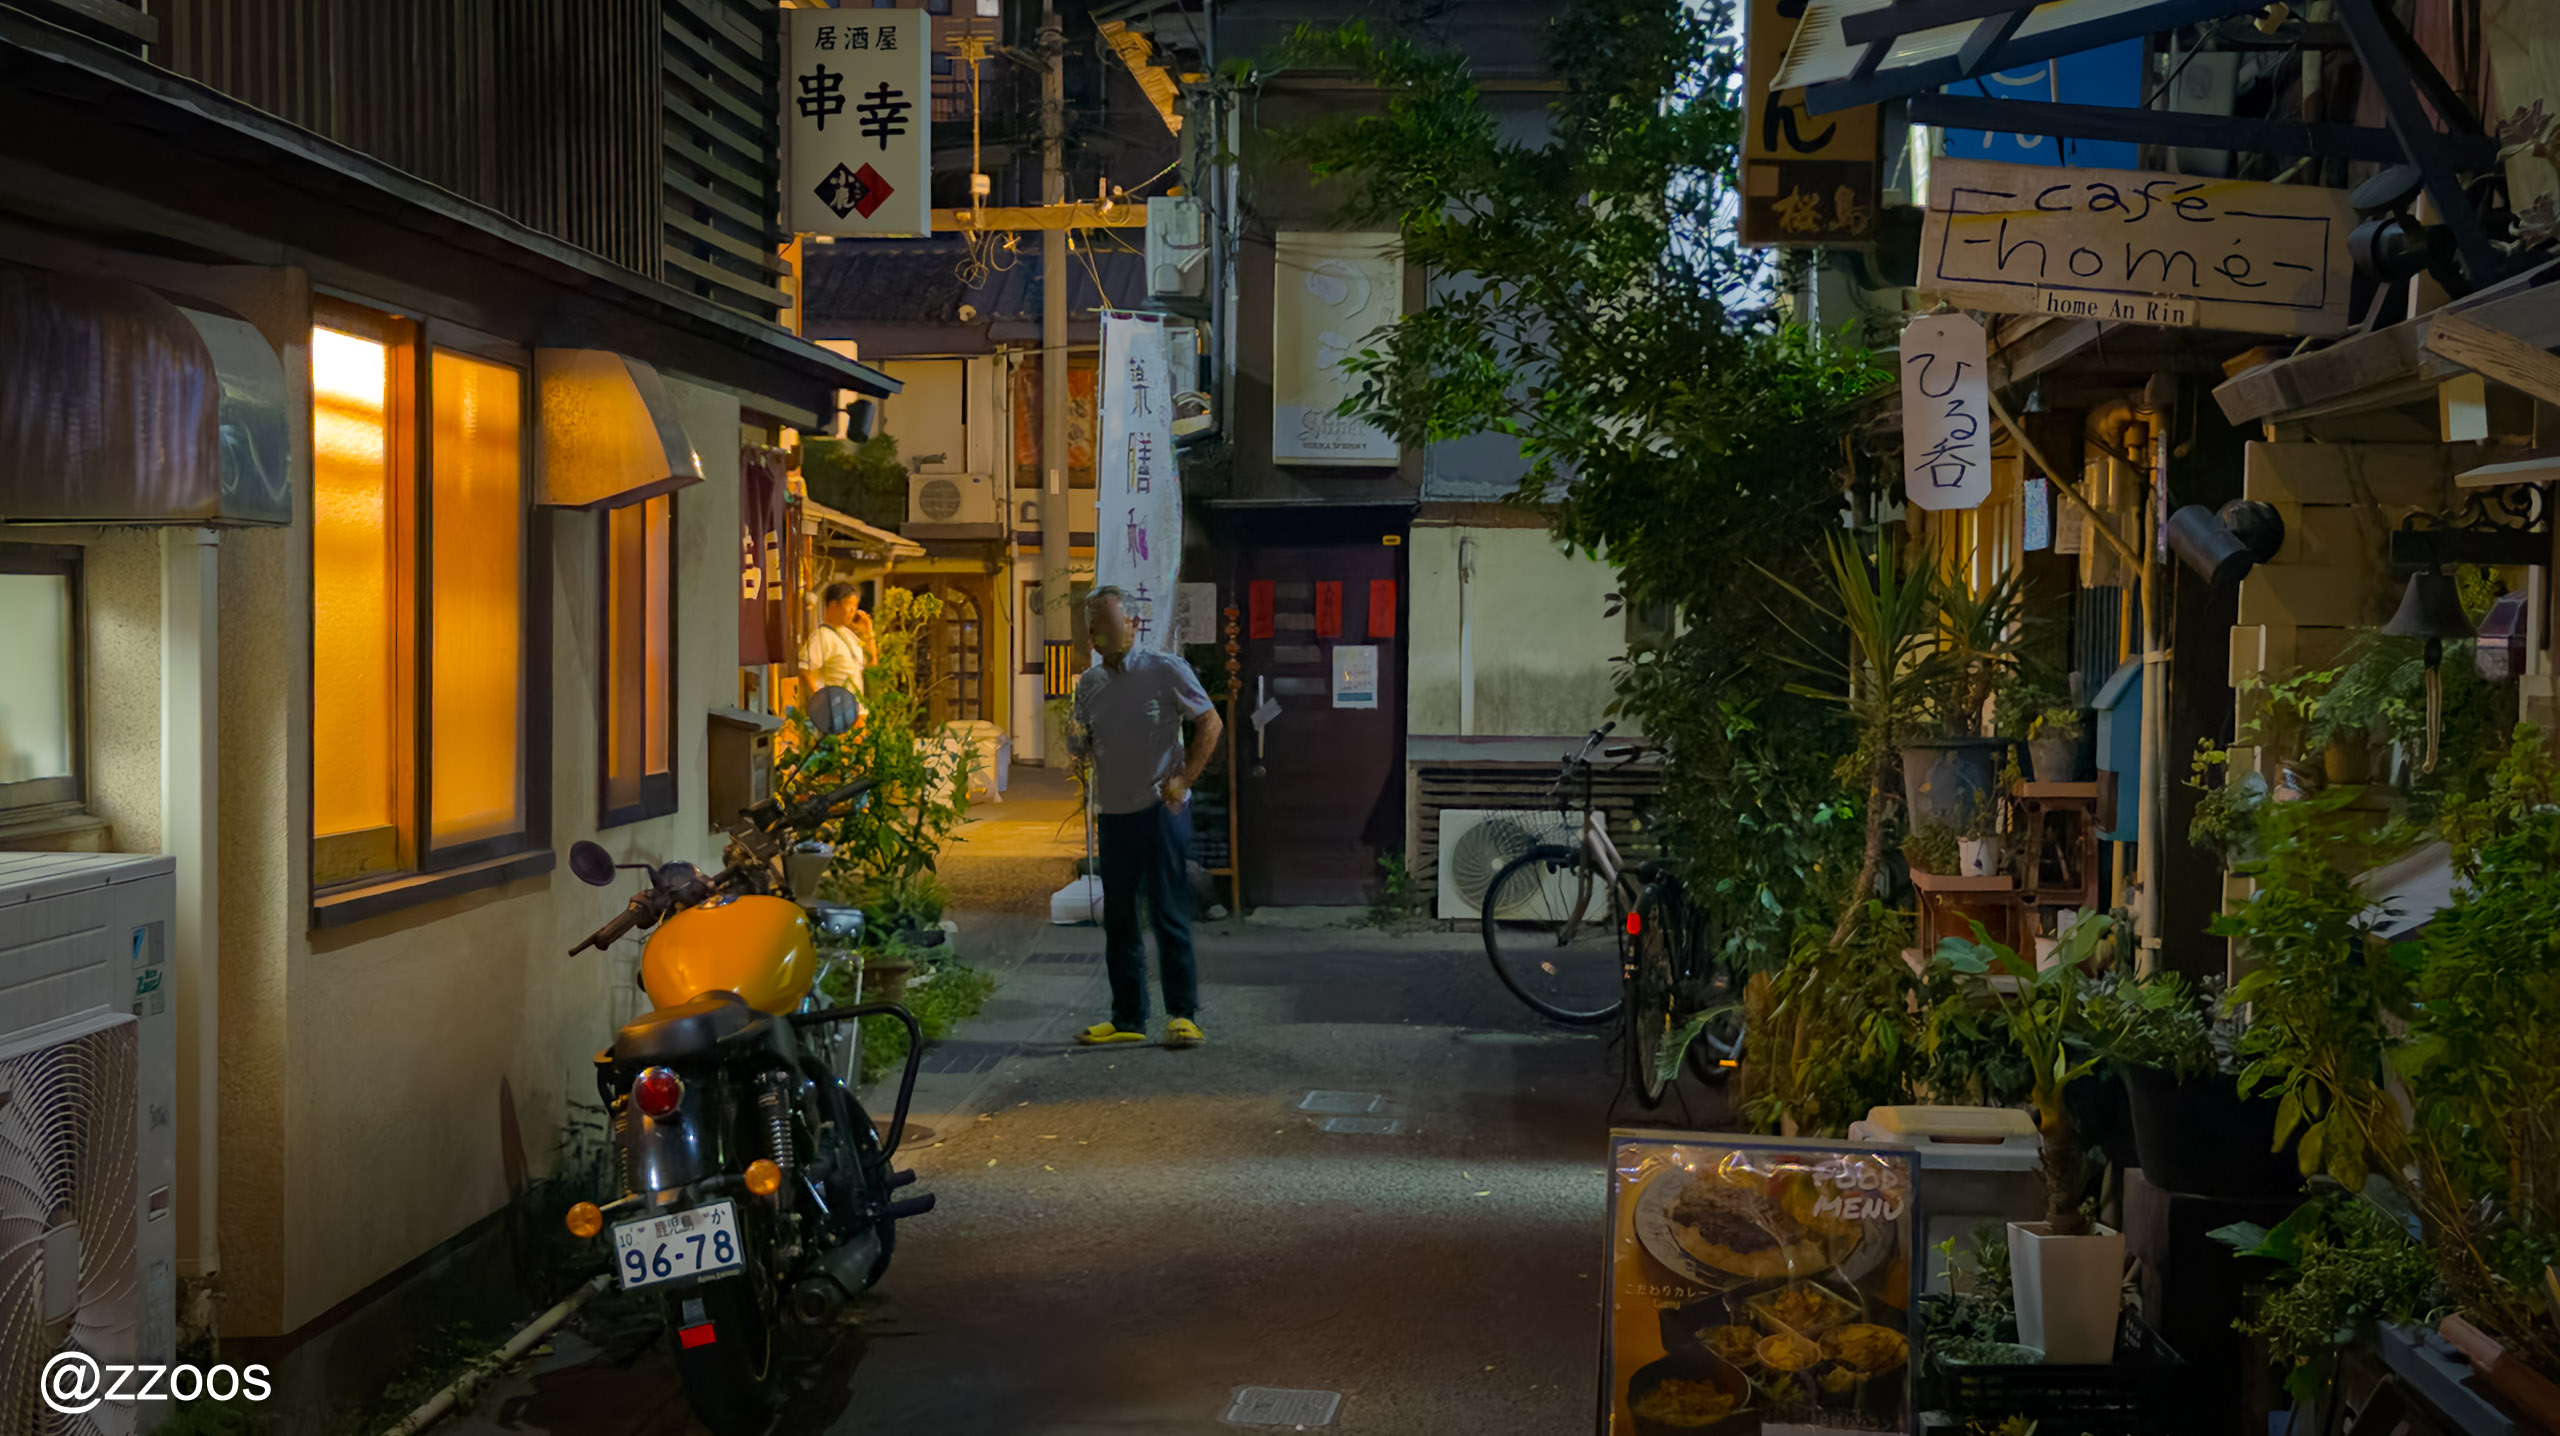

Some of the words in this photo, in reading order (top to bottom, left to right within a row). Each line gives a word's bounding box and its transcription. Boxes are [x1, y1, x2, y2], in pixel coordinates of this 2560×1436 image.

[814, 25, 898, 50] 居酒屋
[796, 63, 912, 151] 串幸
[2047, 292, 2098, 318] home
[2109, 295, 2135, 319] An
[2146, 301, 2186, 324] Rin
[1906, 353, 1978, 488] ひる呑
[1812, 1159, 1899, 1191] FOOD
[711, 1208, 726, 1225] か
[1812, 1194, 1905, 1222] MENU
[625, 1229, 735, 1283] 96-78
[1624, 1283, 1709, 1298] こだわりカレー
